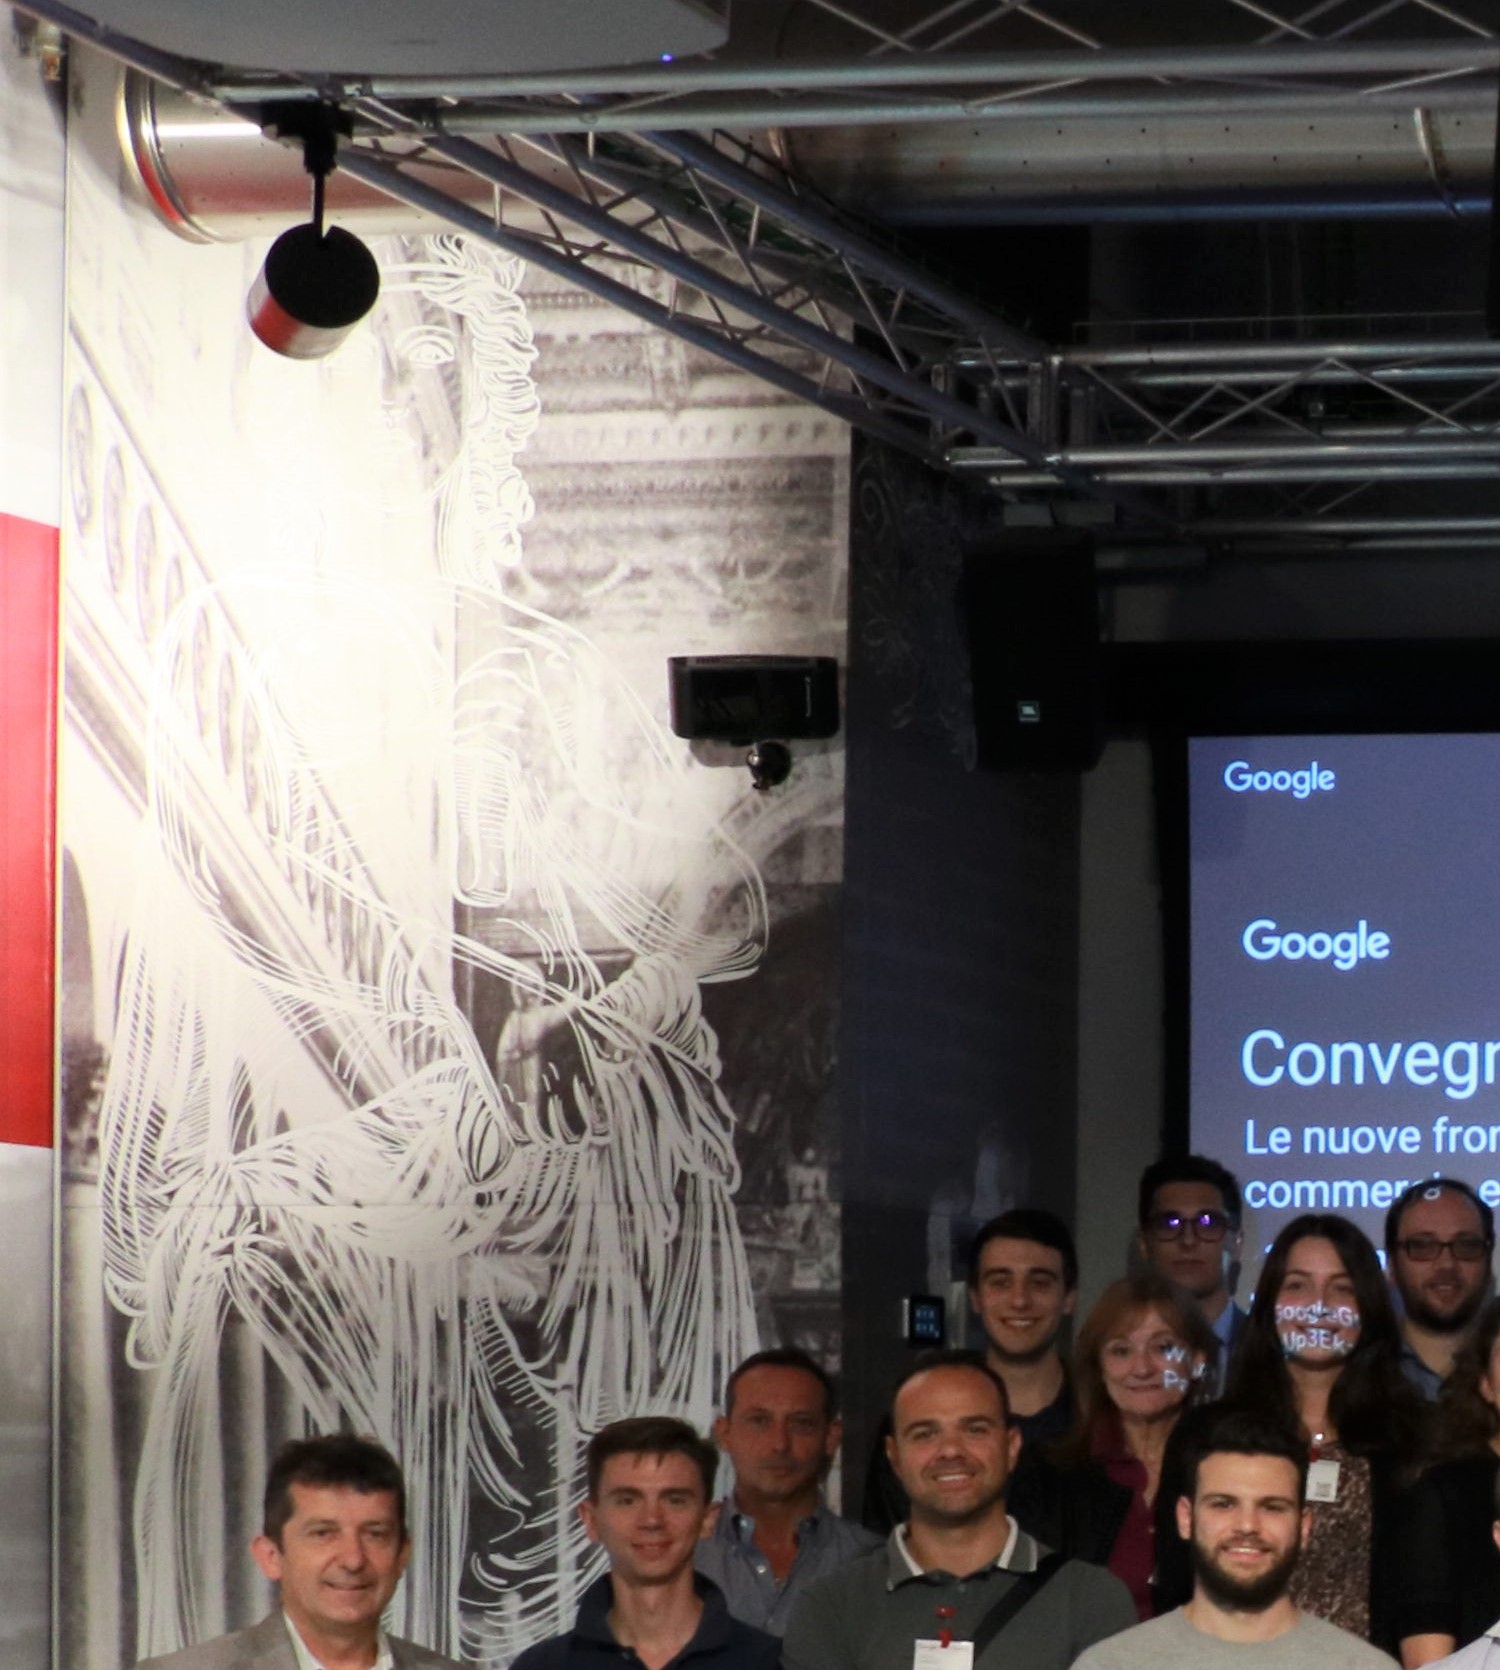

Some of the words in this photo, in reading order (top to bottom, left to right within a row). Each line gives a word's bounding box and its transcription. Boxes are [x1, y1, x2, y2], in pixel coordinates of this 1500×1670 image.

[1223, 760, 1337, 800] Google
[1242, 918, 1391, 972] Google
[1245, 1119, 1293, 1155] Le
[1302, 1125, 1422, 1155] nuove
